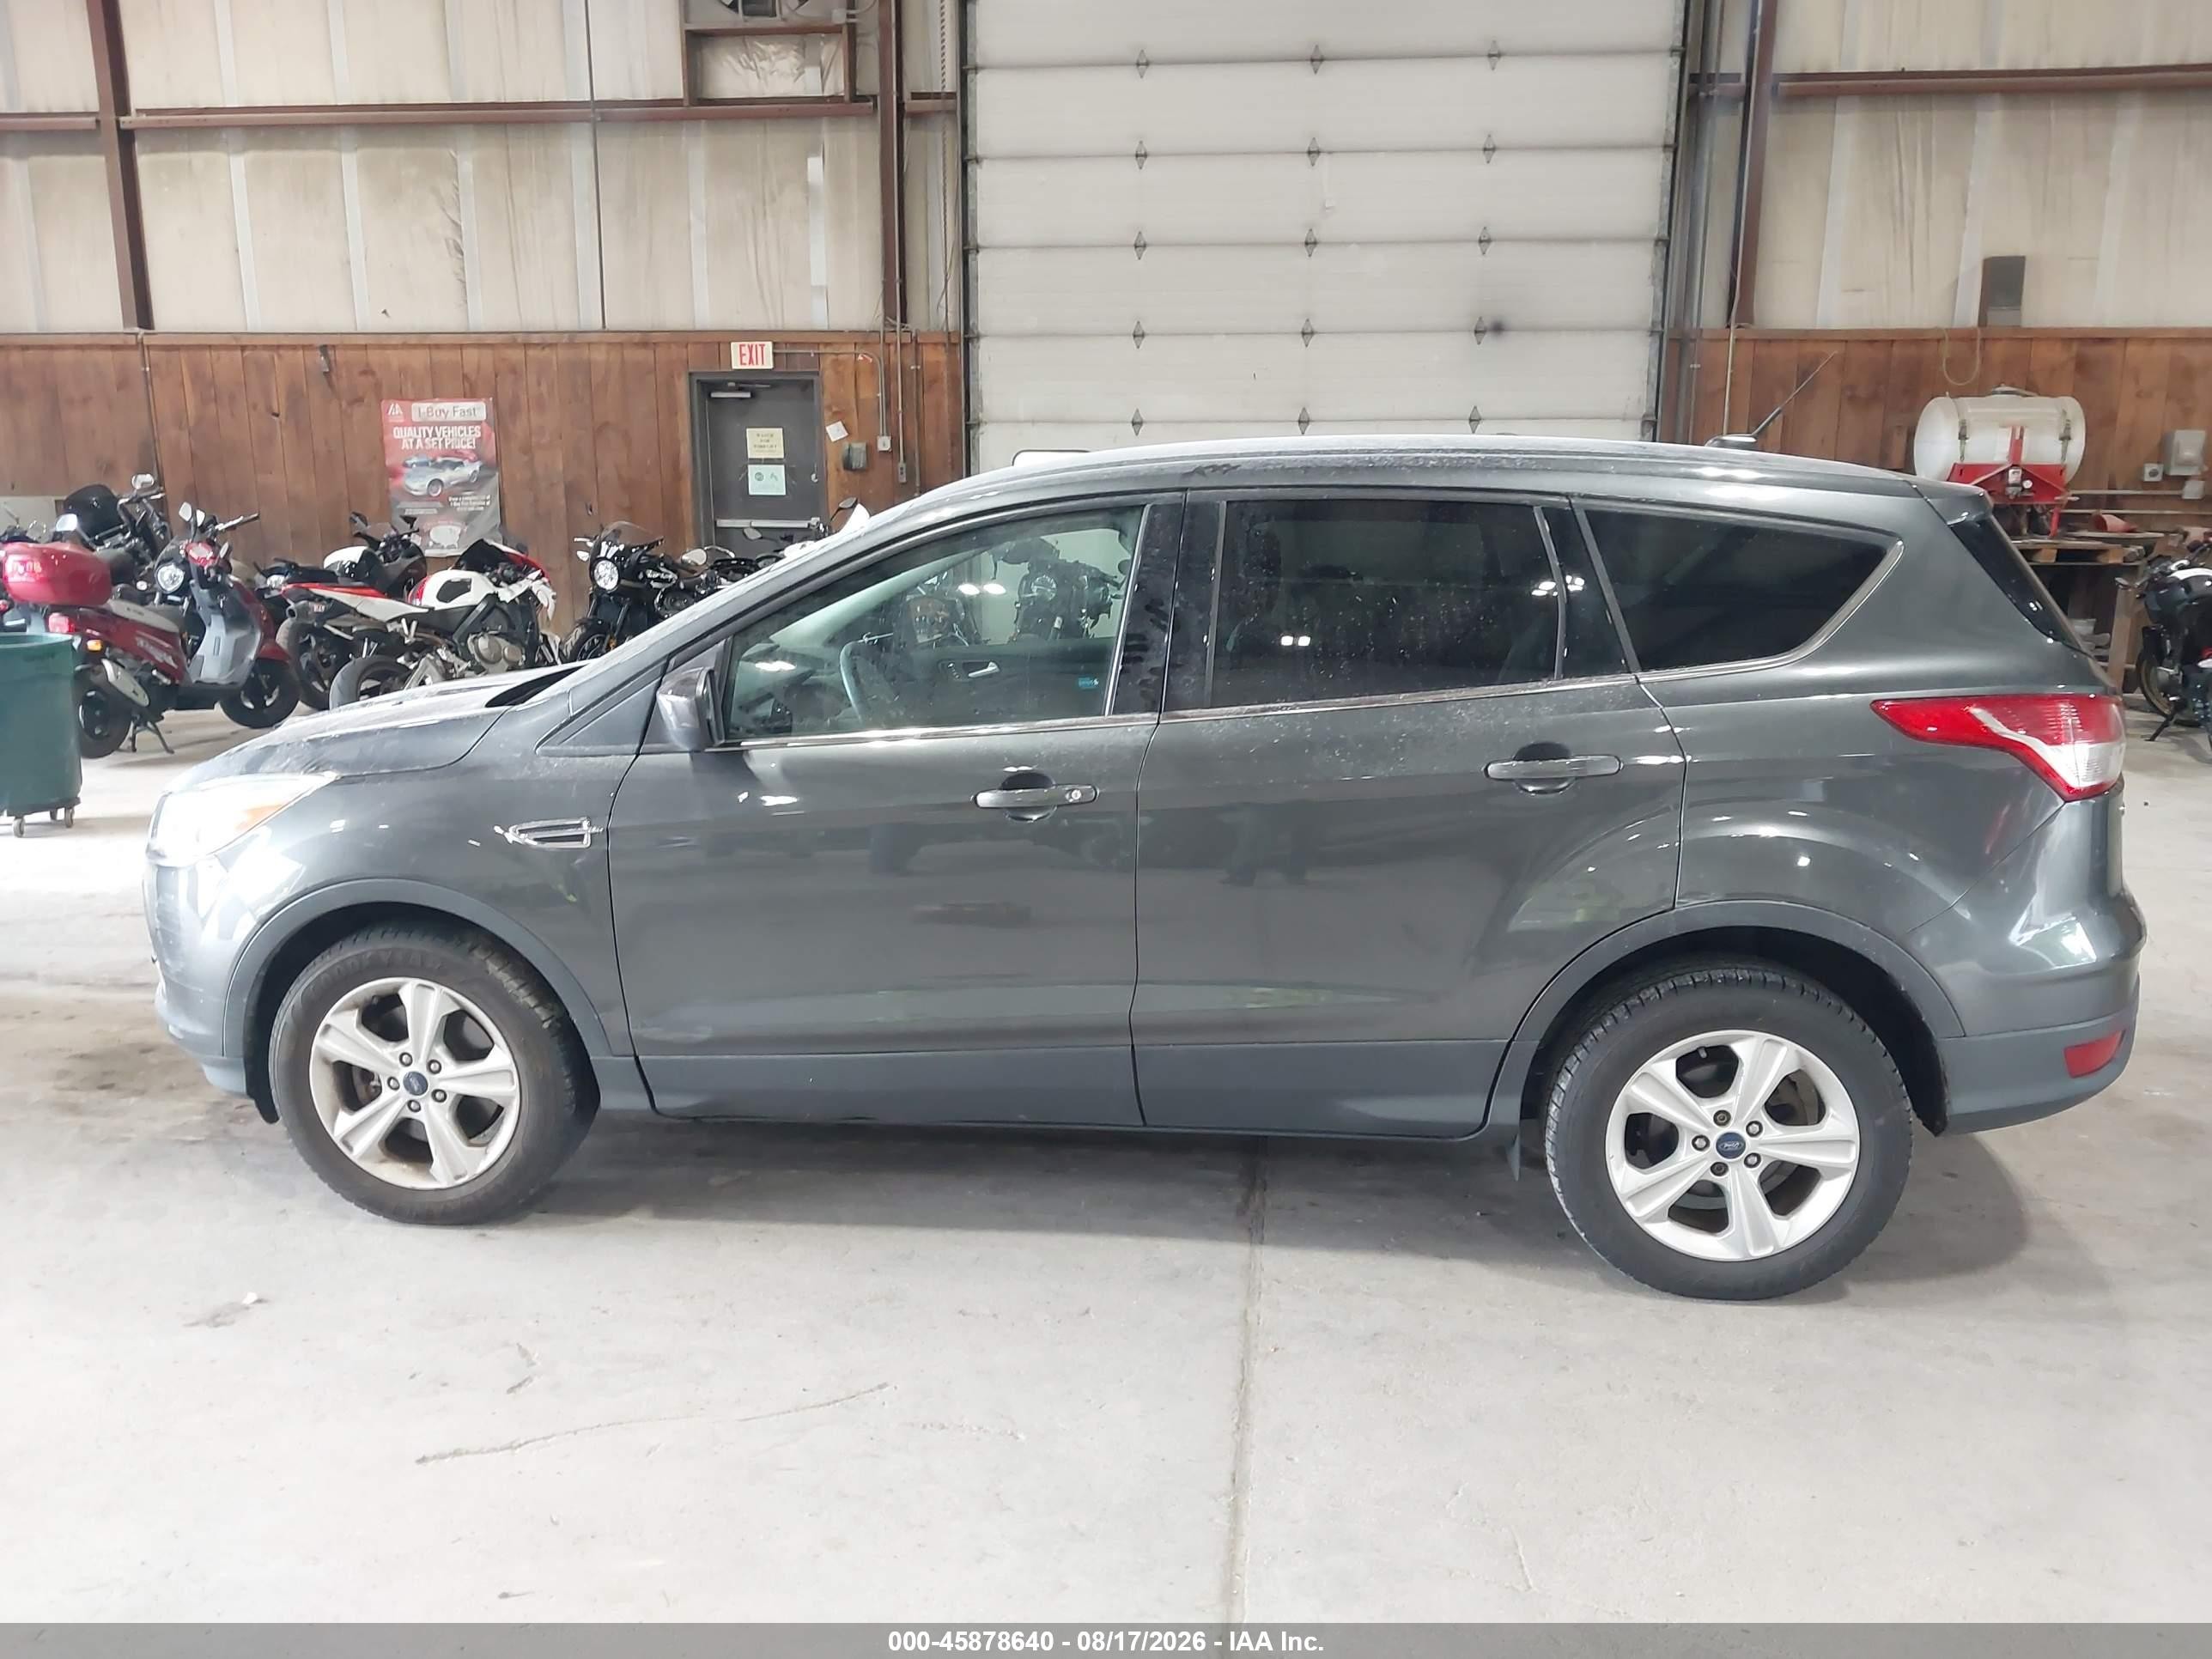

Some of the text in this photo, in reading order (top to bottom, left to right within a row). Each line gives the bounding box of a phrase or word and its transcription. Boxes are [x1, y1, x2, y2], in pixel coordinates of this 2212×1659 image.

[739, 343, 765, 366] EXIT
[453, 405, 477, 417] Fast
[393, 425, 481, 439] QUALITY VEHICLES
[401, 437, 476, 450] AT A SET PRICE!
